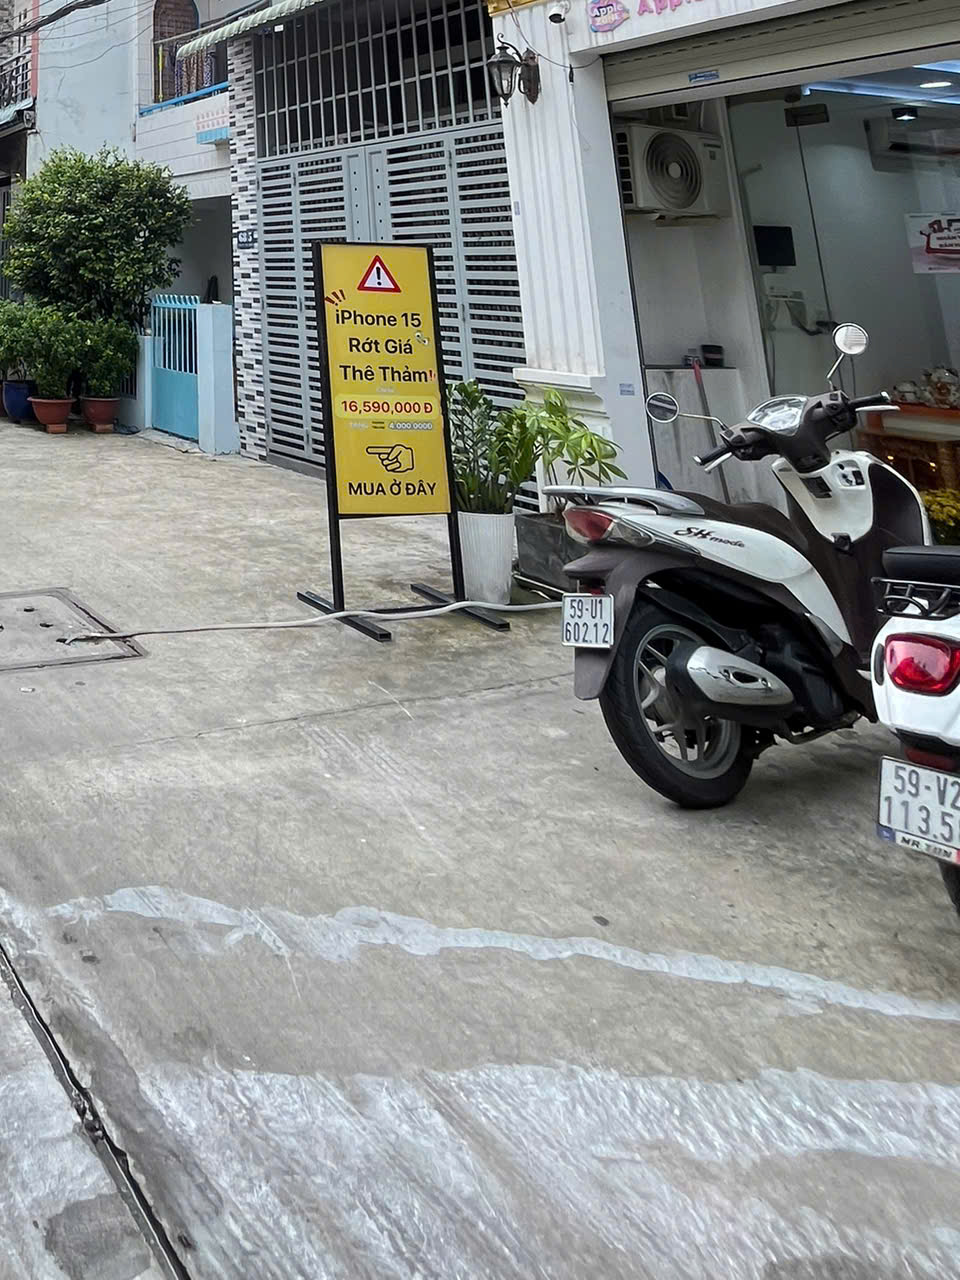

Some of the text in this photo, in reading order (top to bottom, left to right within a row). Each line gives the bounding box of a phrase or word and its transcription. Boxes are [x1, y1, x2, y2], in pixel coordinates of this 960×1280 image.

[335, 309, 422, 327] iPhone 15
[348, 337, 413, 355] Rớt Giá
[339, 365, 375, 381] Thê
[341, 400, 421, 415] 16,590,000
[348, 478, 437, 496] MUA Ở ĐÂY
[570, 598, 603, 620] 59-U1
[565, 621, 609, 644] 602.12
[884, 796, 960, 842] 113.5
